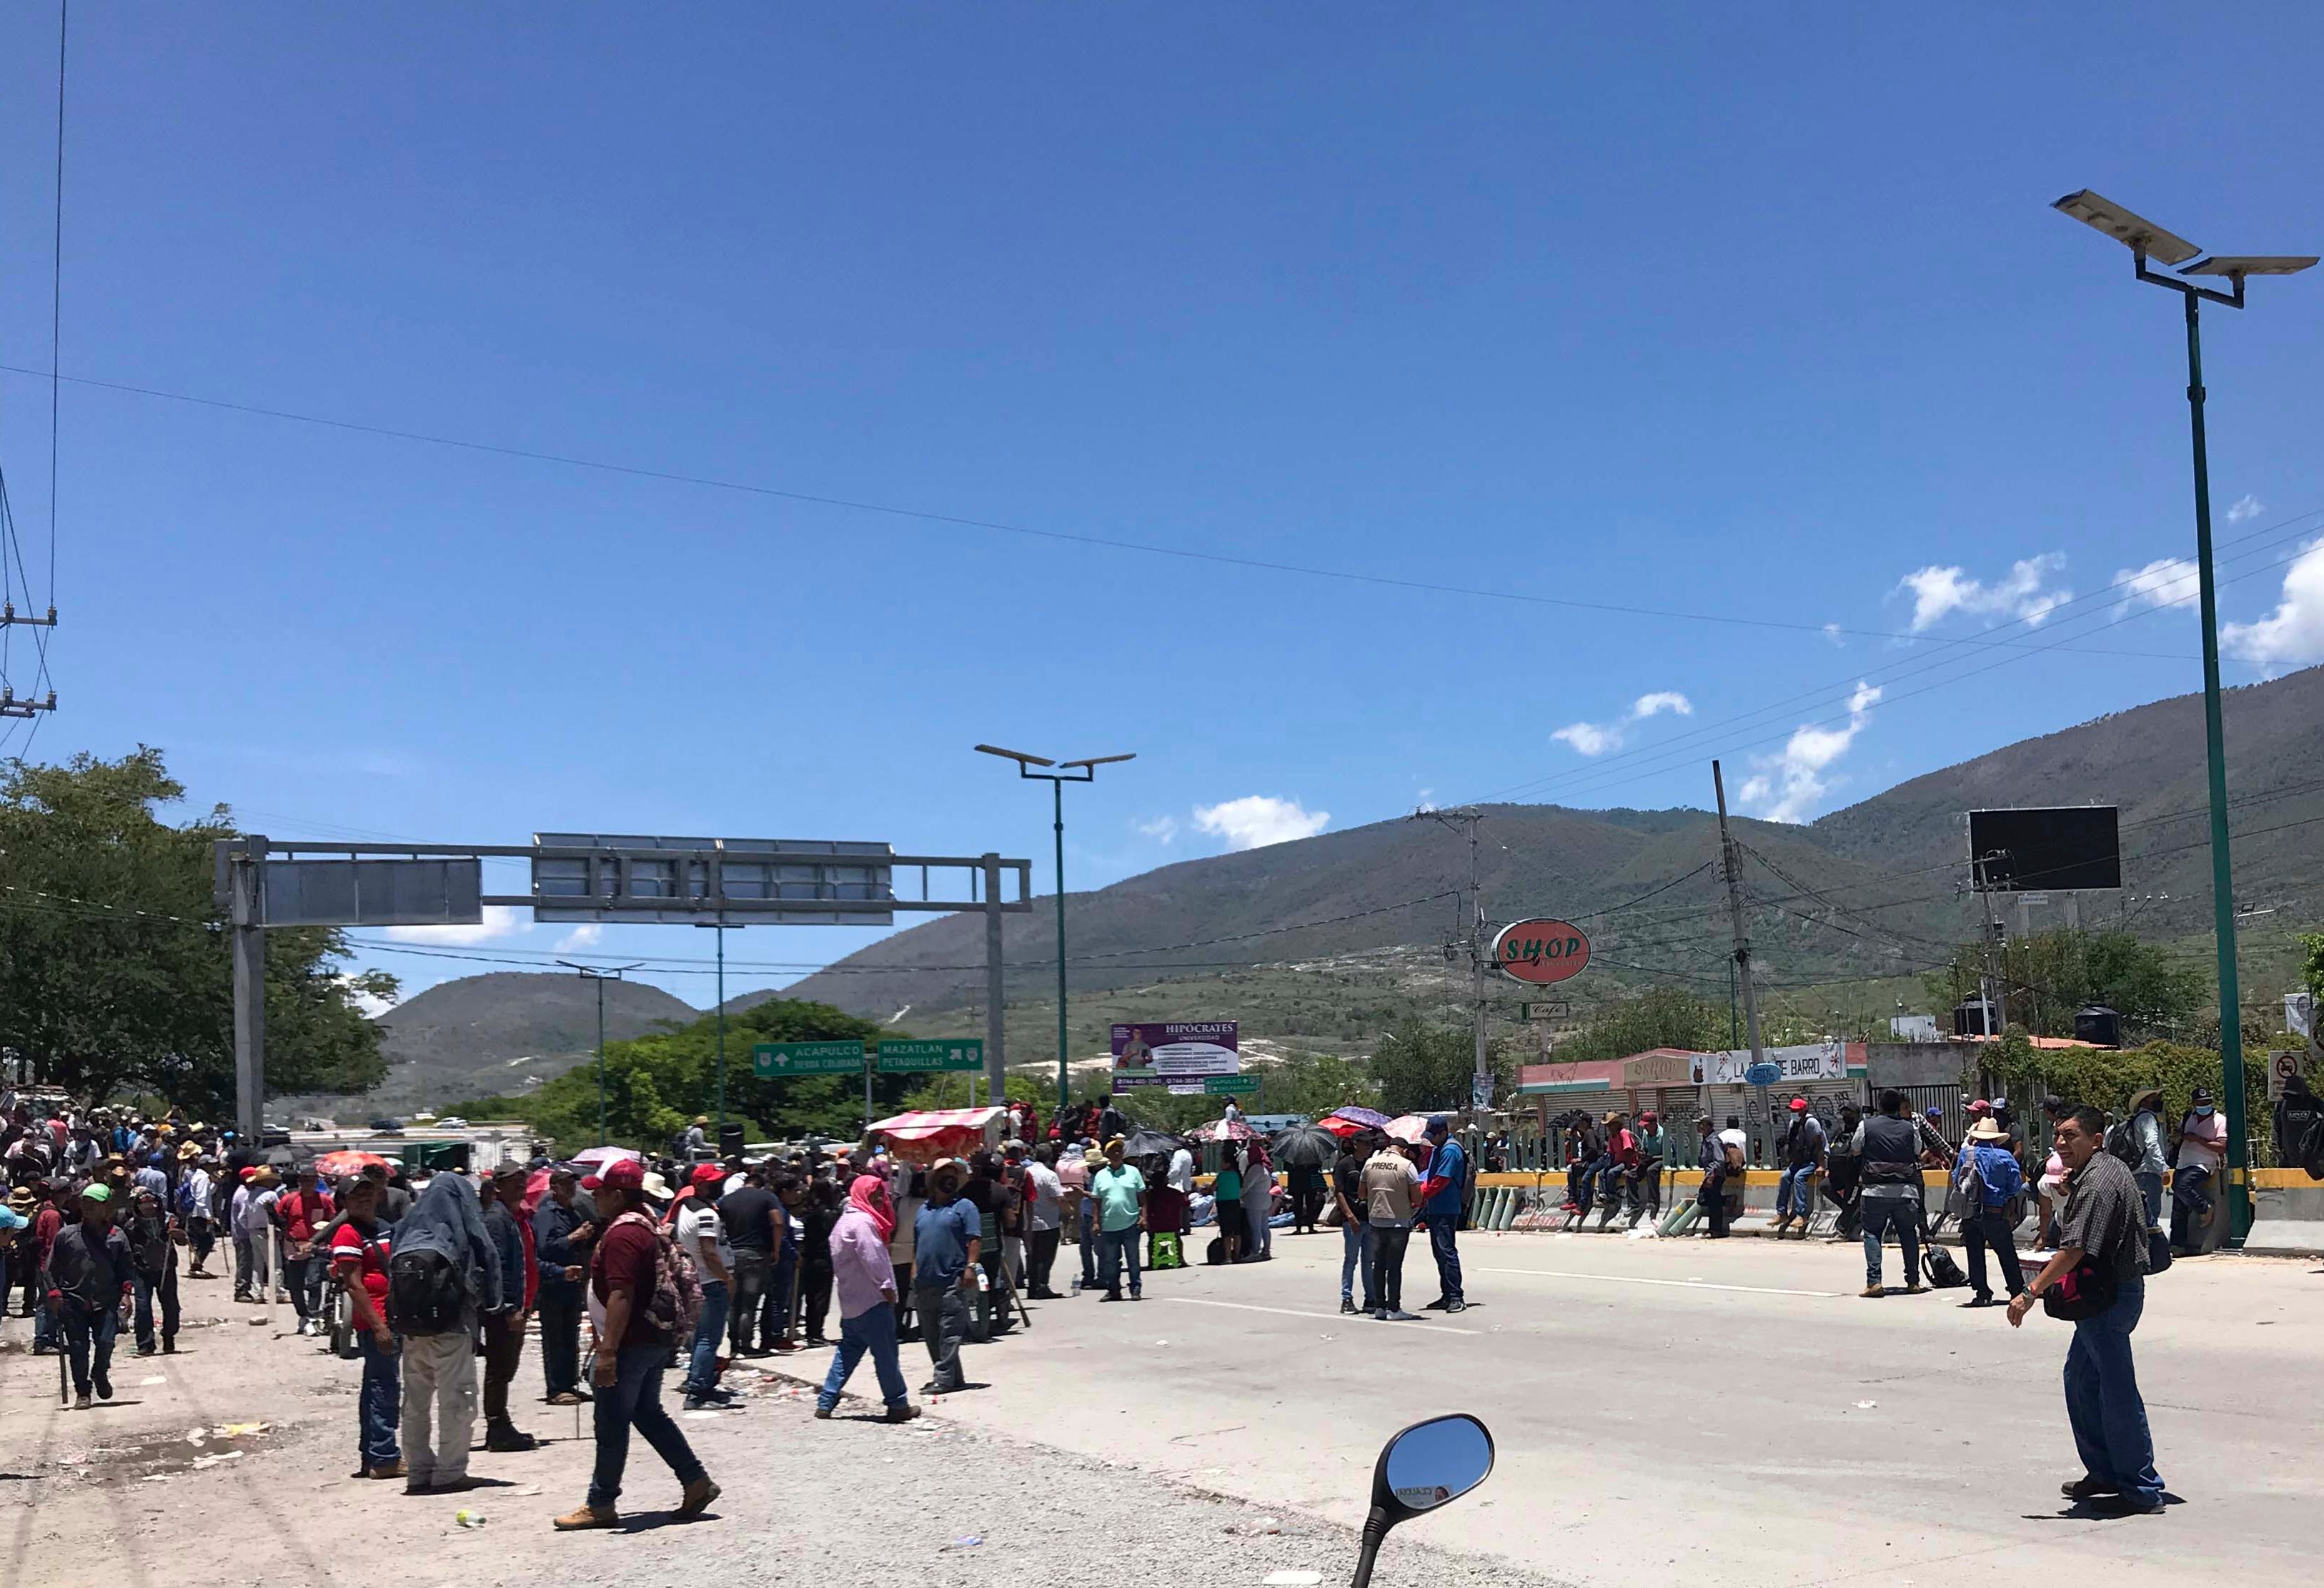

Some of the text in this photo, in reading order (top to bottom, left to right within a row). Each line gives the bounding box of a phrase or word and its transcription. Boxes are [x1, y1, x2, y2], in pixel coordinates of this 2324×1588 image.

[1506, 938, 1580, 959] SHOP
[796, 1046, 860, 1056] ACAPULCO
[883, 1045, 943, 1054] MAZATLAN
[883, 1057, 943, 1067] PETAQUILLAS
[1734, 1061, 1745, 1078] LA
[1791, 1058, 1819, 1076] BARRO
[1371, 1162, 1398, 1171] PRENSA
